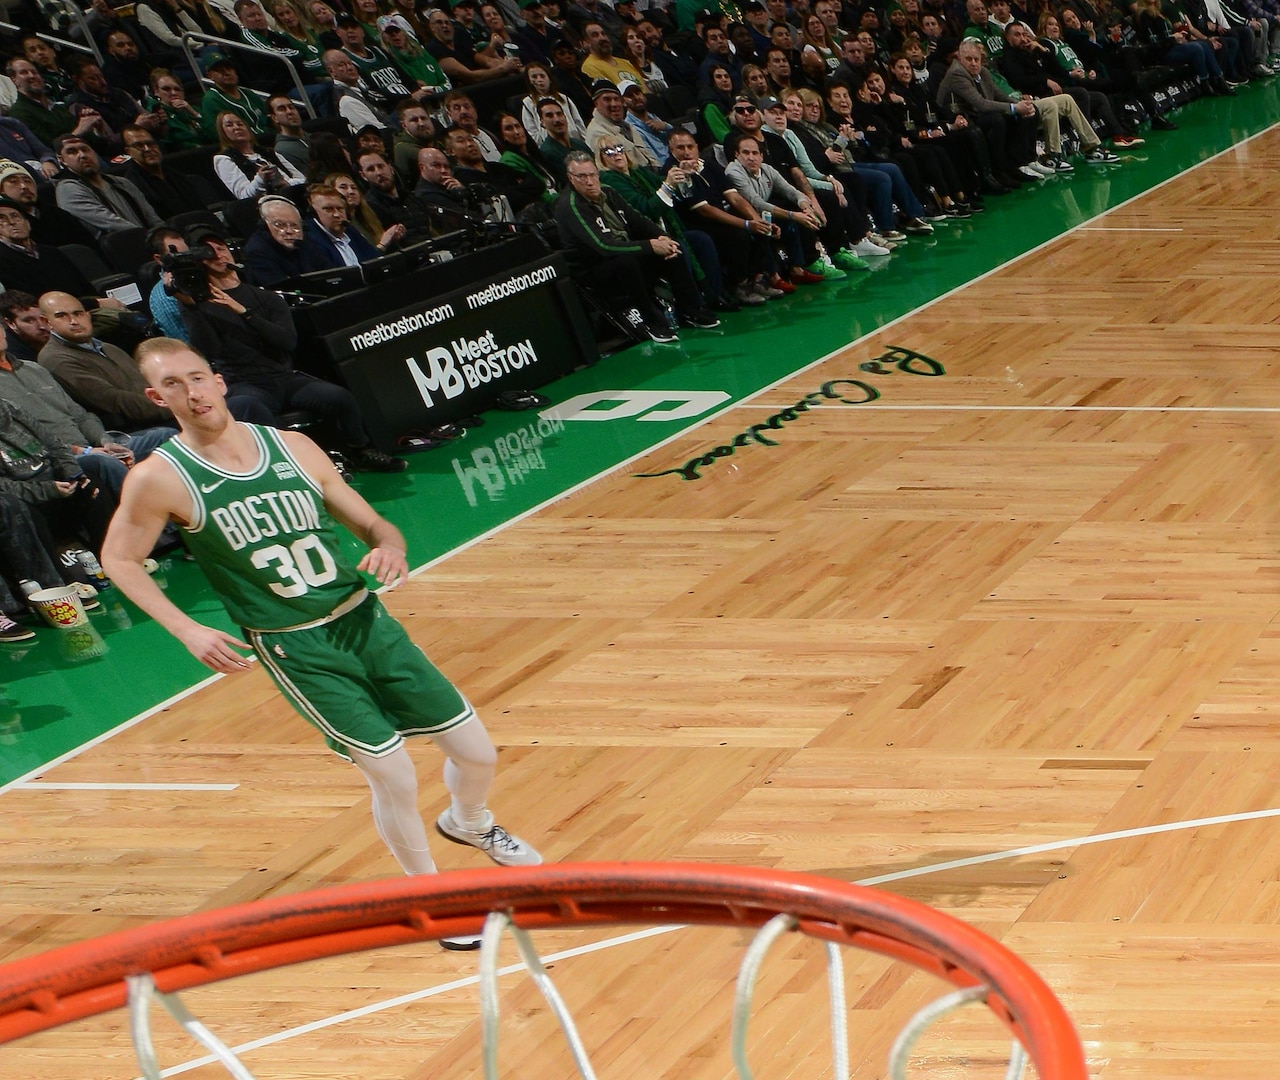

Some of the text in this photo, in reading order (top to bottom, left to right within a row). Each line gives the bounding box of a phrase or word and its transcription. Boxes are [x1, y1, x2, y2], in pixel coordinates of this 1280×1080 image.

[350, 264, 556, 351] meetboston.com meetboston.com
[451, 330, 498, 364] Meet
[462, 339, 538, 389] BOSTON
[211, 489, 322, 551] BOSTON
[250, 533, 338, 598] 30
